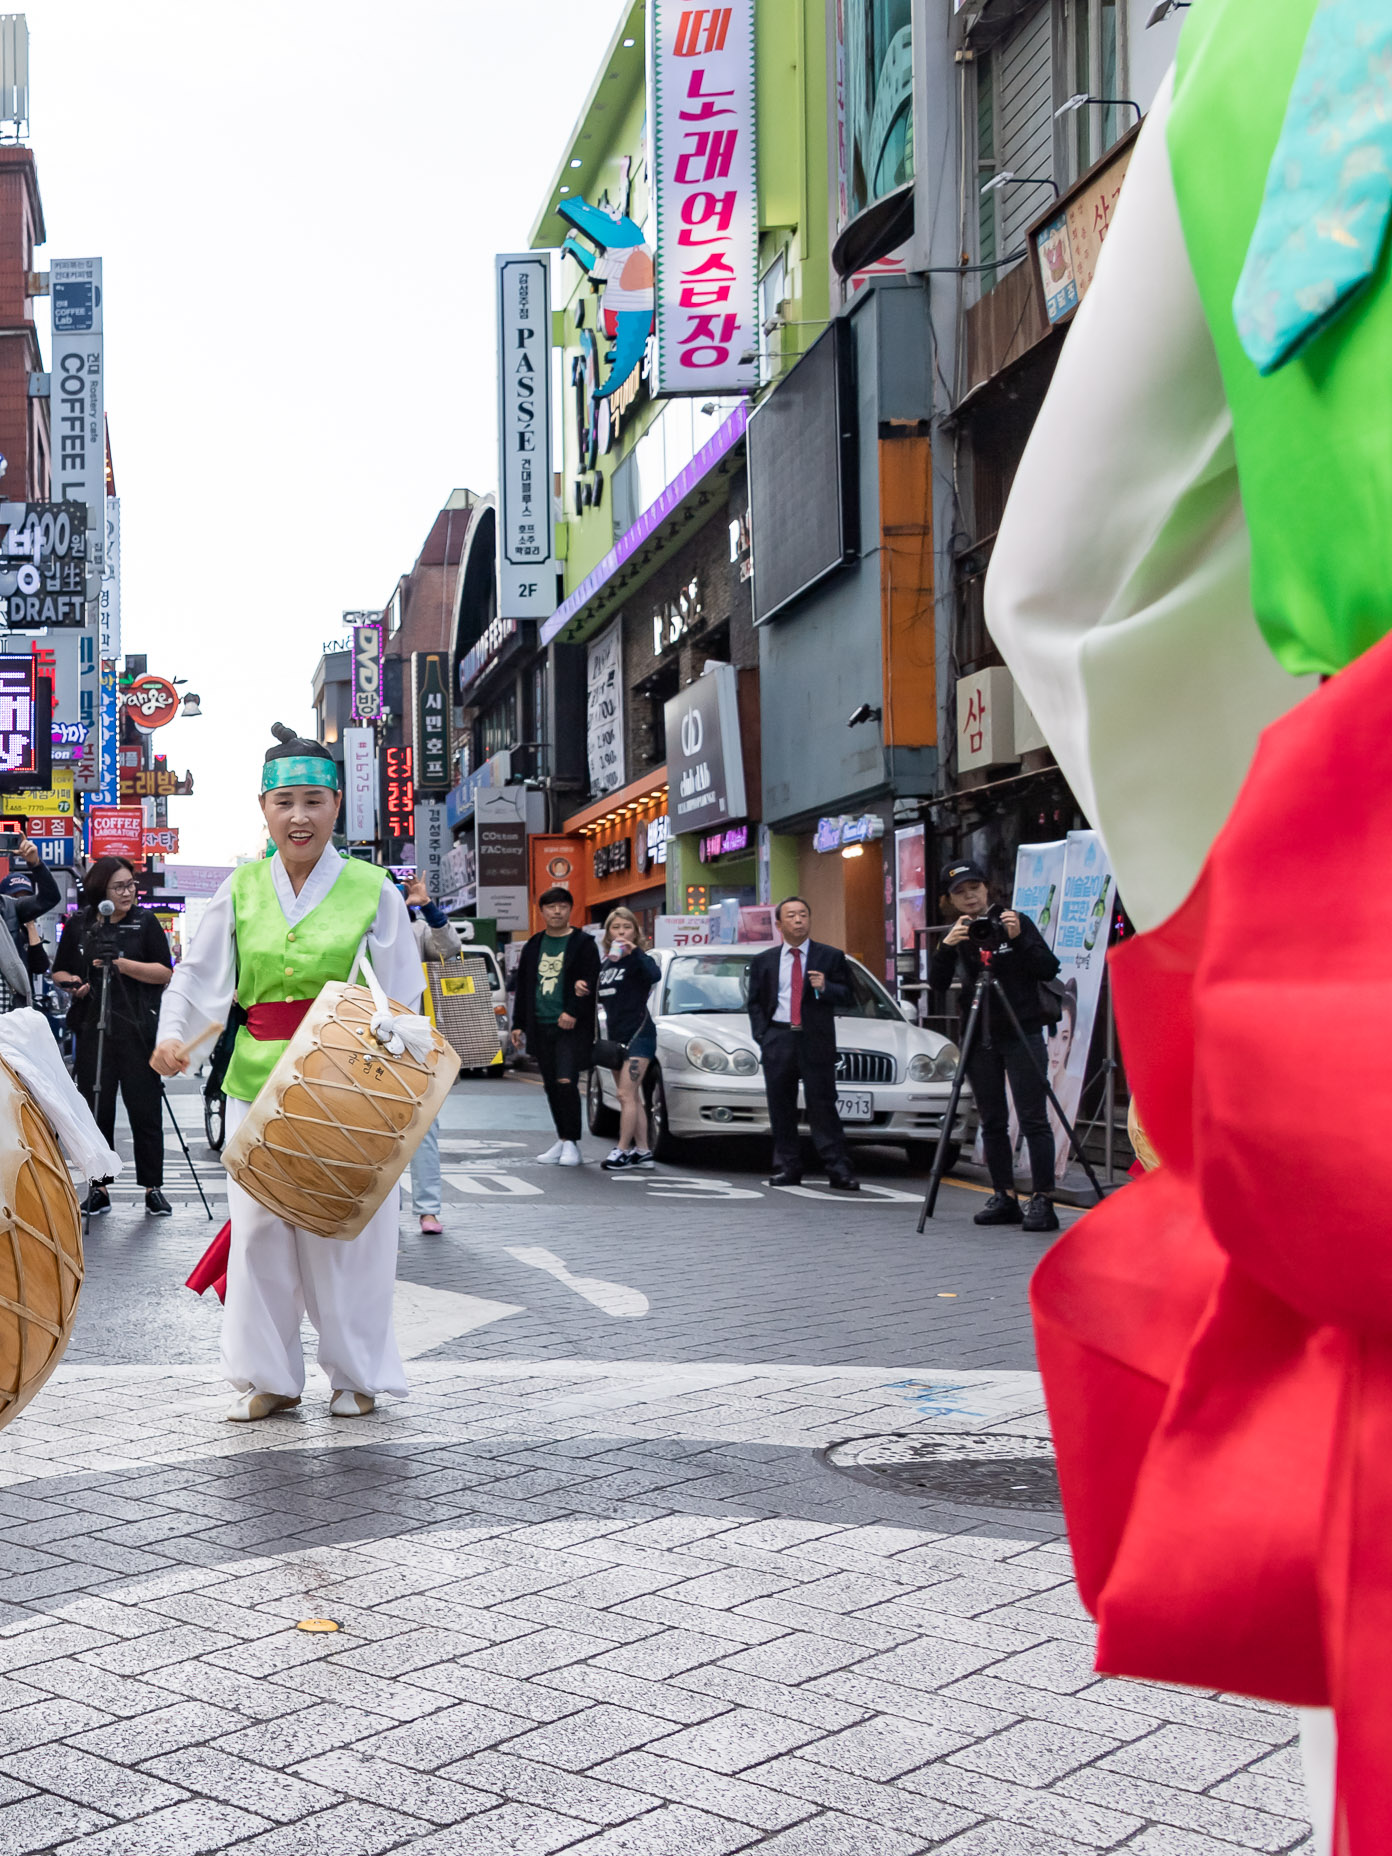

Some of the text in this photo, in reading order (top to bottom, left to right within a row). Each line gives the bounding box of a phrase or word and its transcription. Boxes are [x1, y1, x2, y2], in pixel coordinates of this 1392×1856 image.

[674, 69, 741, 369] 노래연습장
[55, 308, 86, 316] COFFEE
[55, 316, 73, 325] Lab
[515, 328, 536, 452] PASSÉ
[60, 353, 86, 471] COFFEE
[518, 583, 538, 598] 2F
[10, 597, 85, 622] DRAFT
[963, 688, 986, 754] 삼
[424, 692, 443, 778] 시민호프
[94, 817, 140, 829] COFFEE
[94, 827, 140, 838] LABORATORY
[837, 1099, 870, 1115] 7913
